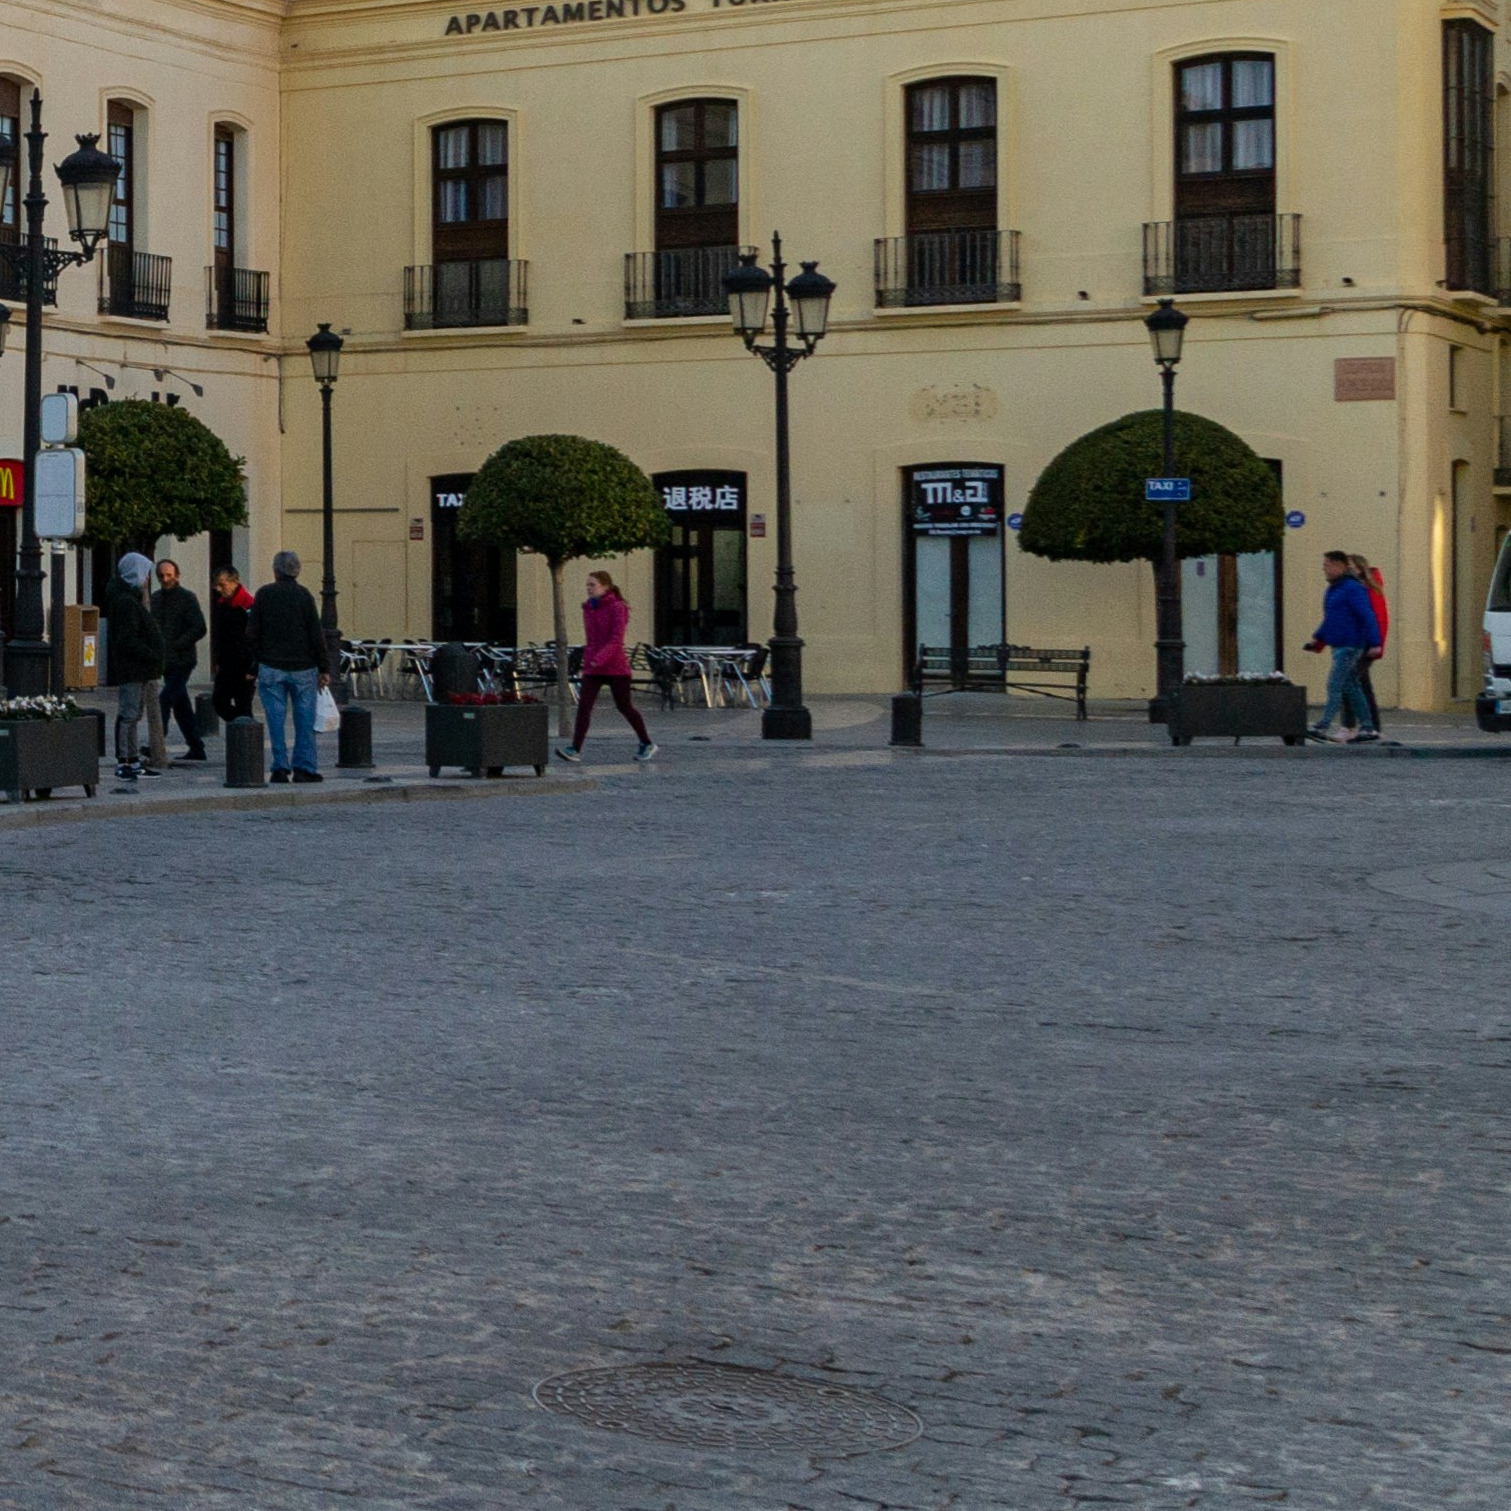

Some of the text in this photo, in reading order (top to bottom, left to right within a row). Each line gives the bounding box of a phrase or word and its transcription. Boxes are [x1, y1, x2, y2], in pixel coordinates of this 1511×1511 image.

[1148, 480, 1174, 491] TAXI
[663, 484, 739, 510] 退税店
